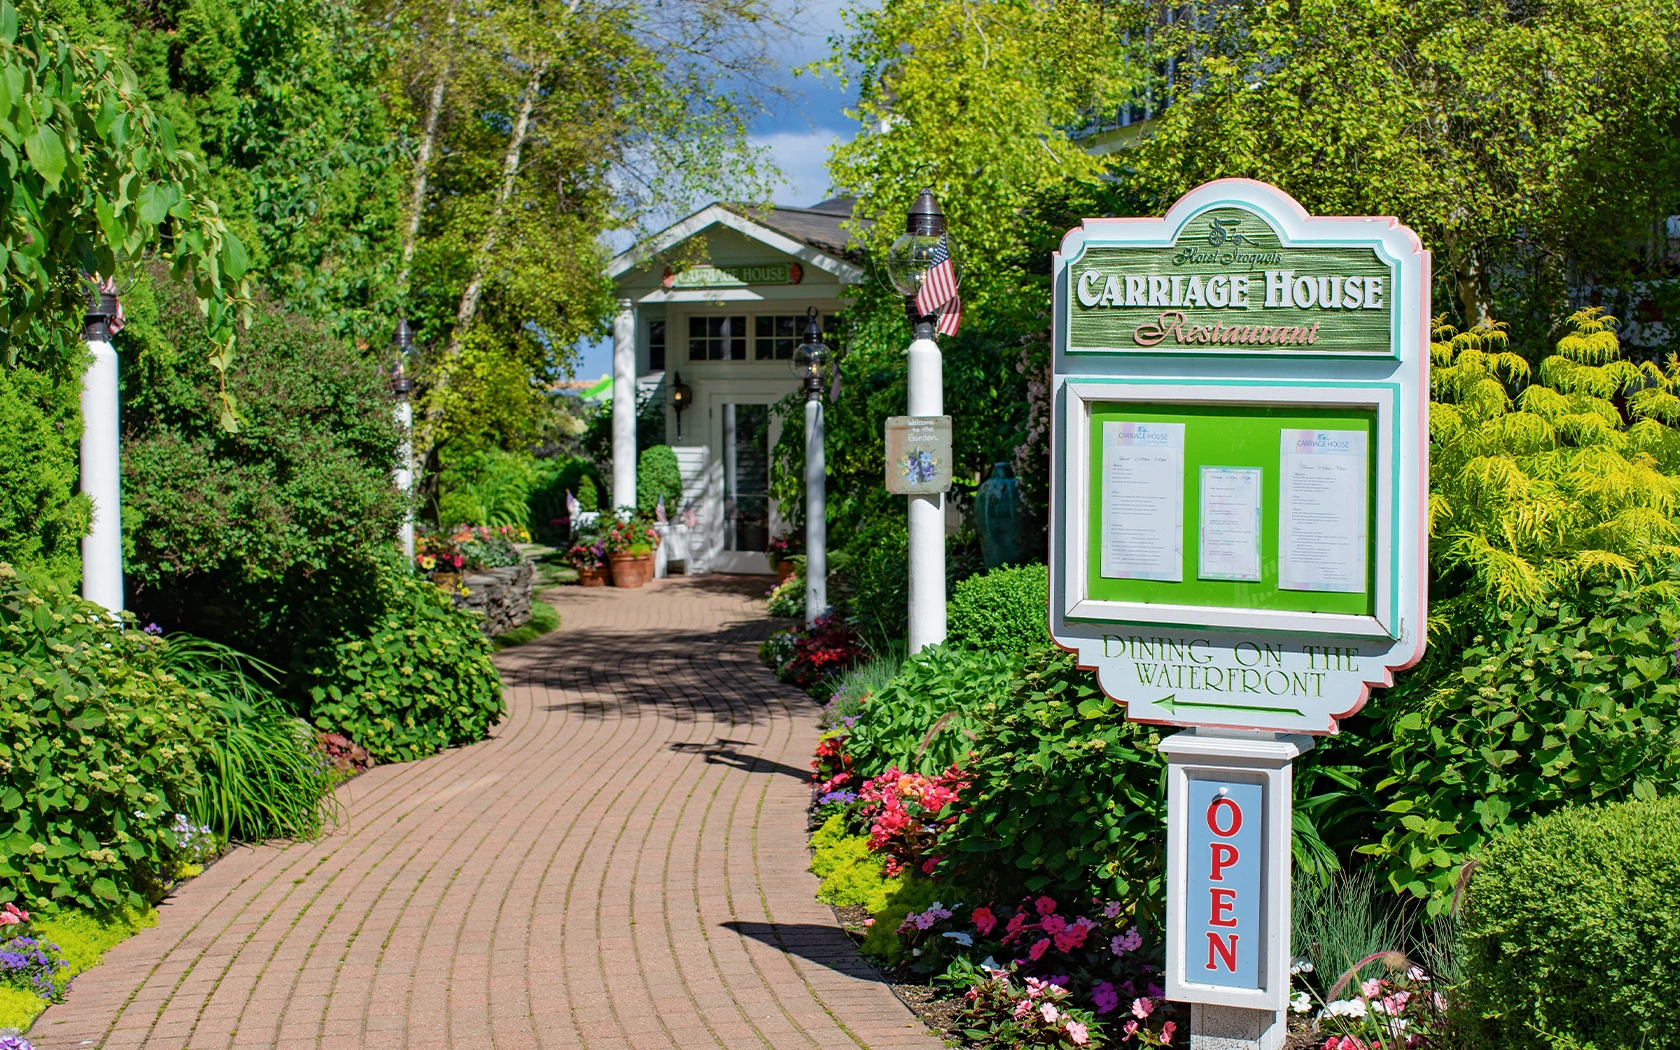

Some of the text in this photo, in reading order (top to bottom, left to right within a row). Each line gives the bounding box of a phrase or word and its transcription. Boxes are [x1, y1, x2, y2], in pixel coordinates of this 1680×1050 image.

[680, 267, 785, 282] CARRIAGE HOUSE
[1172, 247, 1282, 270] Hotel Iroquois
[1077, 269, 1384, 310] CARRIAGE HOUSE
[1133, 312, 1321, 347] Restaurant
[1147, 433, 1168, 441] HOUSE
[1297, 440, 1349, 449] CARRIAGE HOUSE
[1101, 634, 1360, 672] DINING ON THE
[1133, 662, 1327, 697] WATERFRONT
[1205, 798, 1243, 974] OPEN
